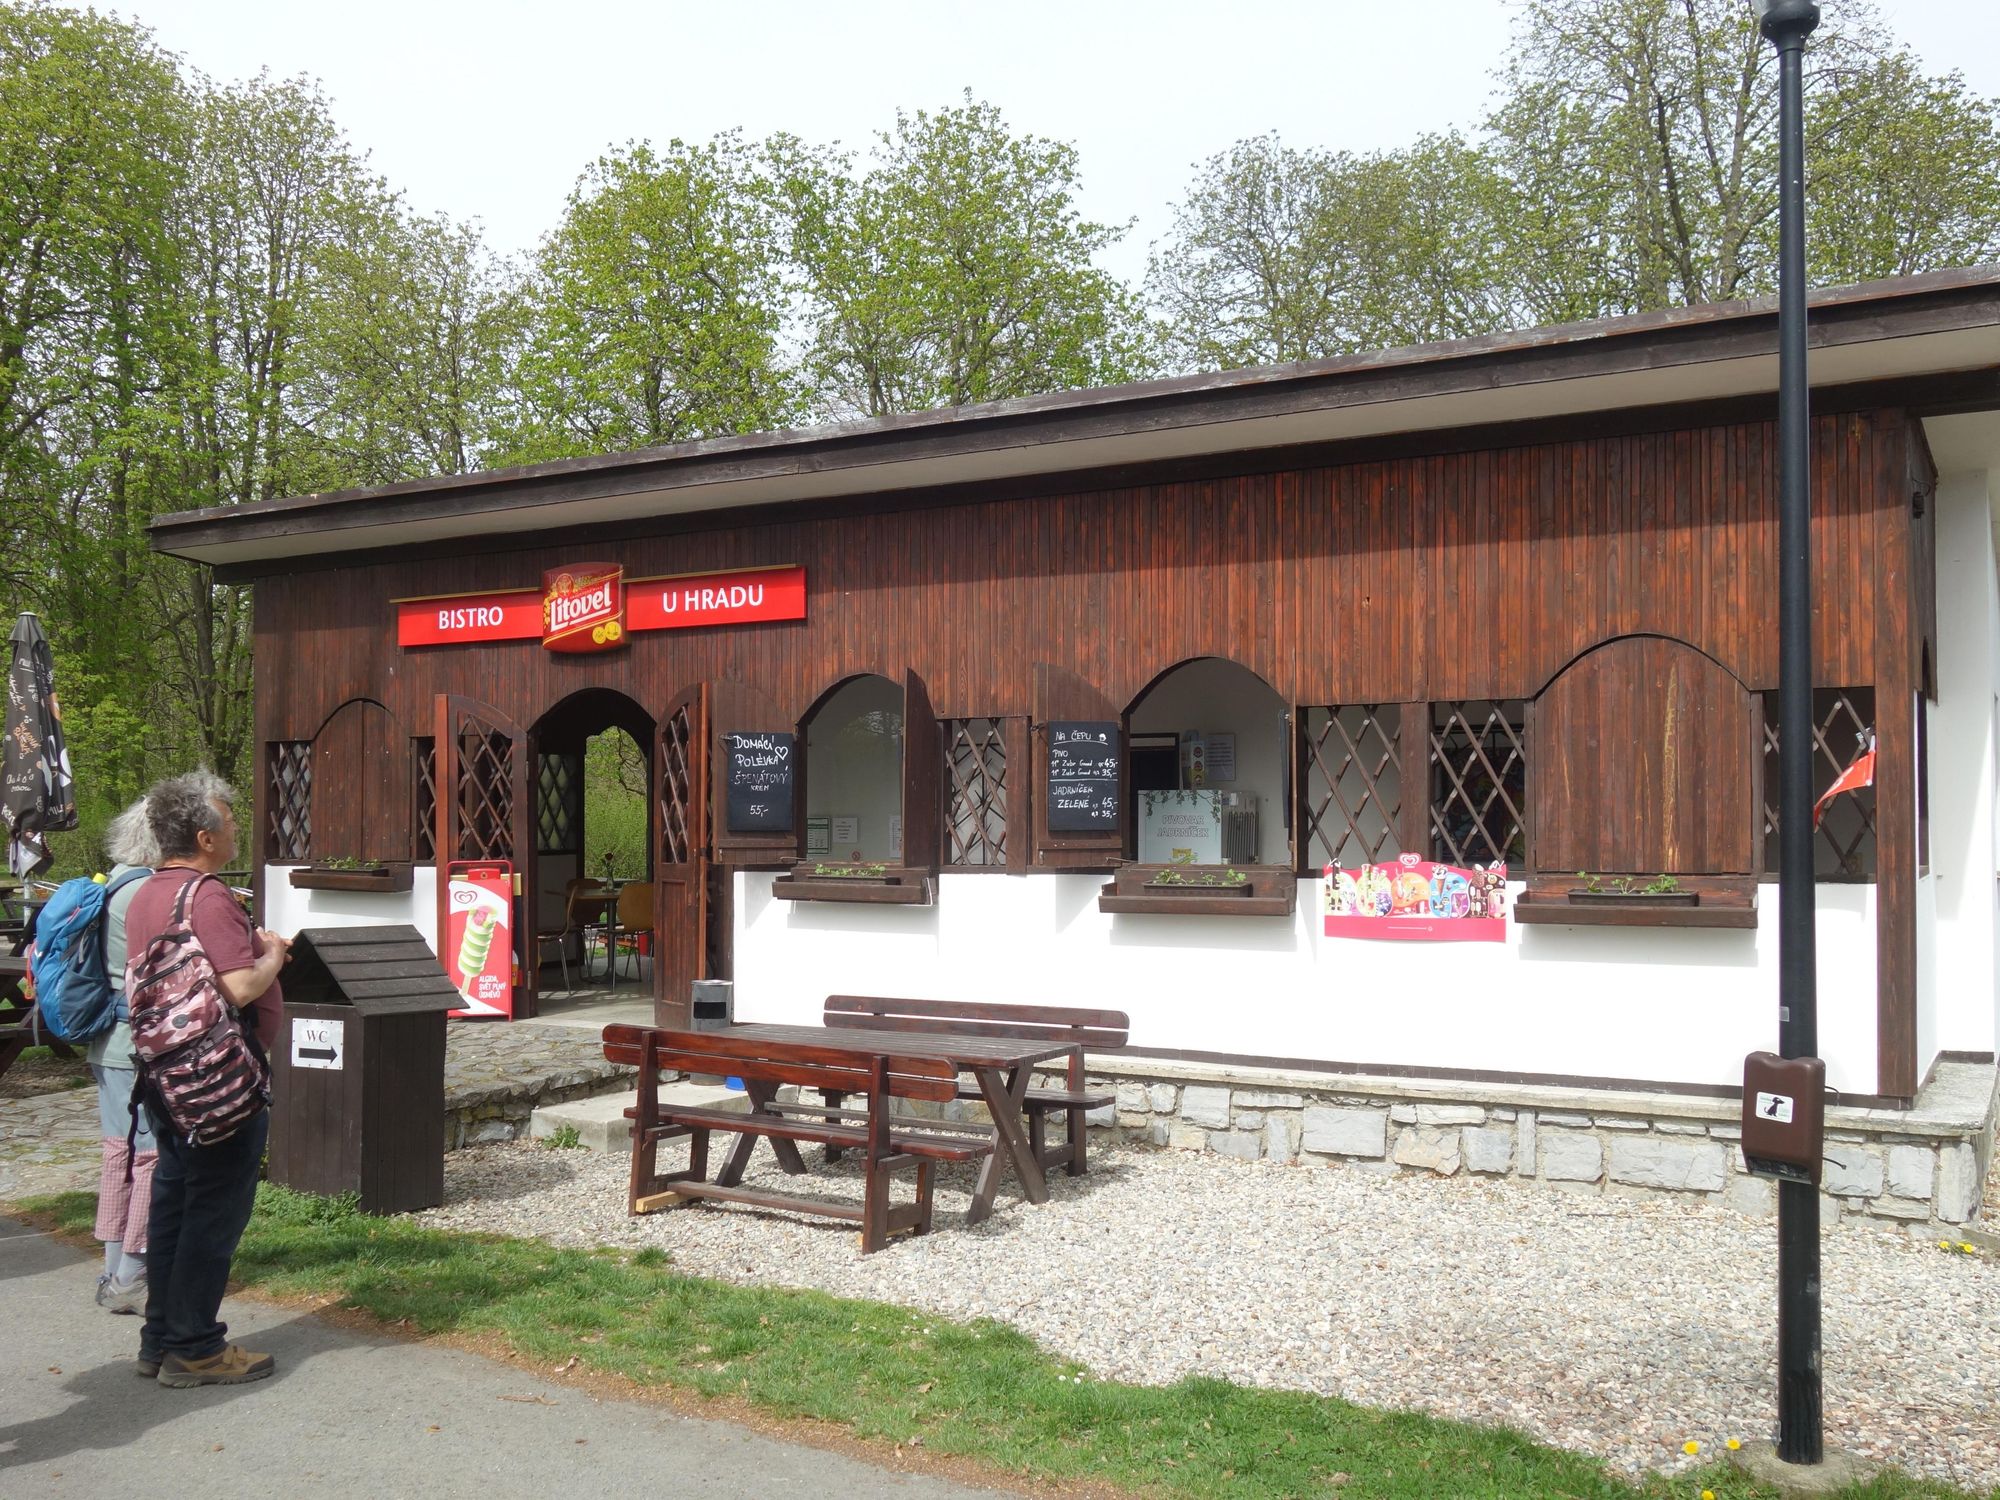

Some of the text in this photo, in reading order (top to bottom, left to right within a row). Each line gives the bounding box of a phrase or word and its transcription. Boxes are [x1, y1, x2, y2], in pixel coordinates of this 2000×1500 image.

[662, 584, 764, 613] U HRADU
[550, 582, 612, 632] Litovel
[438, 606, 504, 630] BISTRO
[733, 734, 775, 750] DOMÁCÍ
[1055, 730, 1091, 741] NA ČEPU
[734, 752, 779, 767] POLÉVKA
[1052, 749, 1069, 758] PIVO
[734, 766, 789, 785] ŠPENÁTOVÝ
[1057, 796, 1089, 809] ZELENÉ
[1162, 815, 1204, 825] PIVOVAR
[306, 1030, 328, 1044] WC
